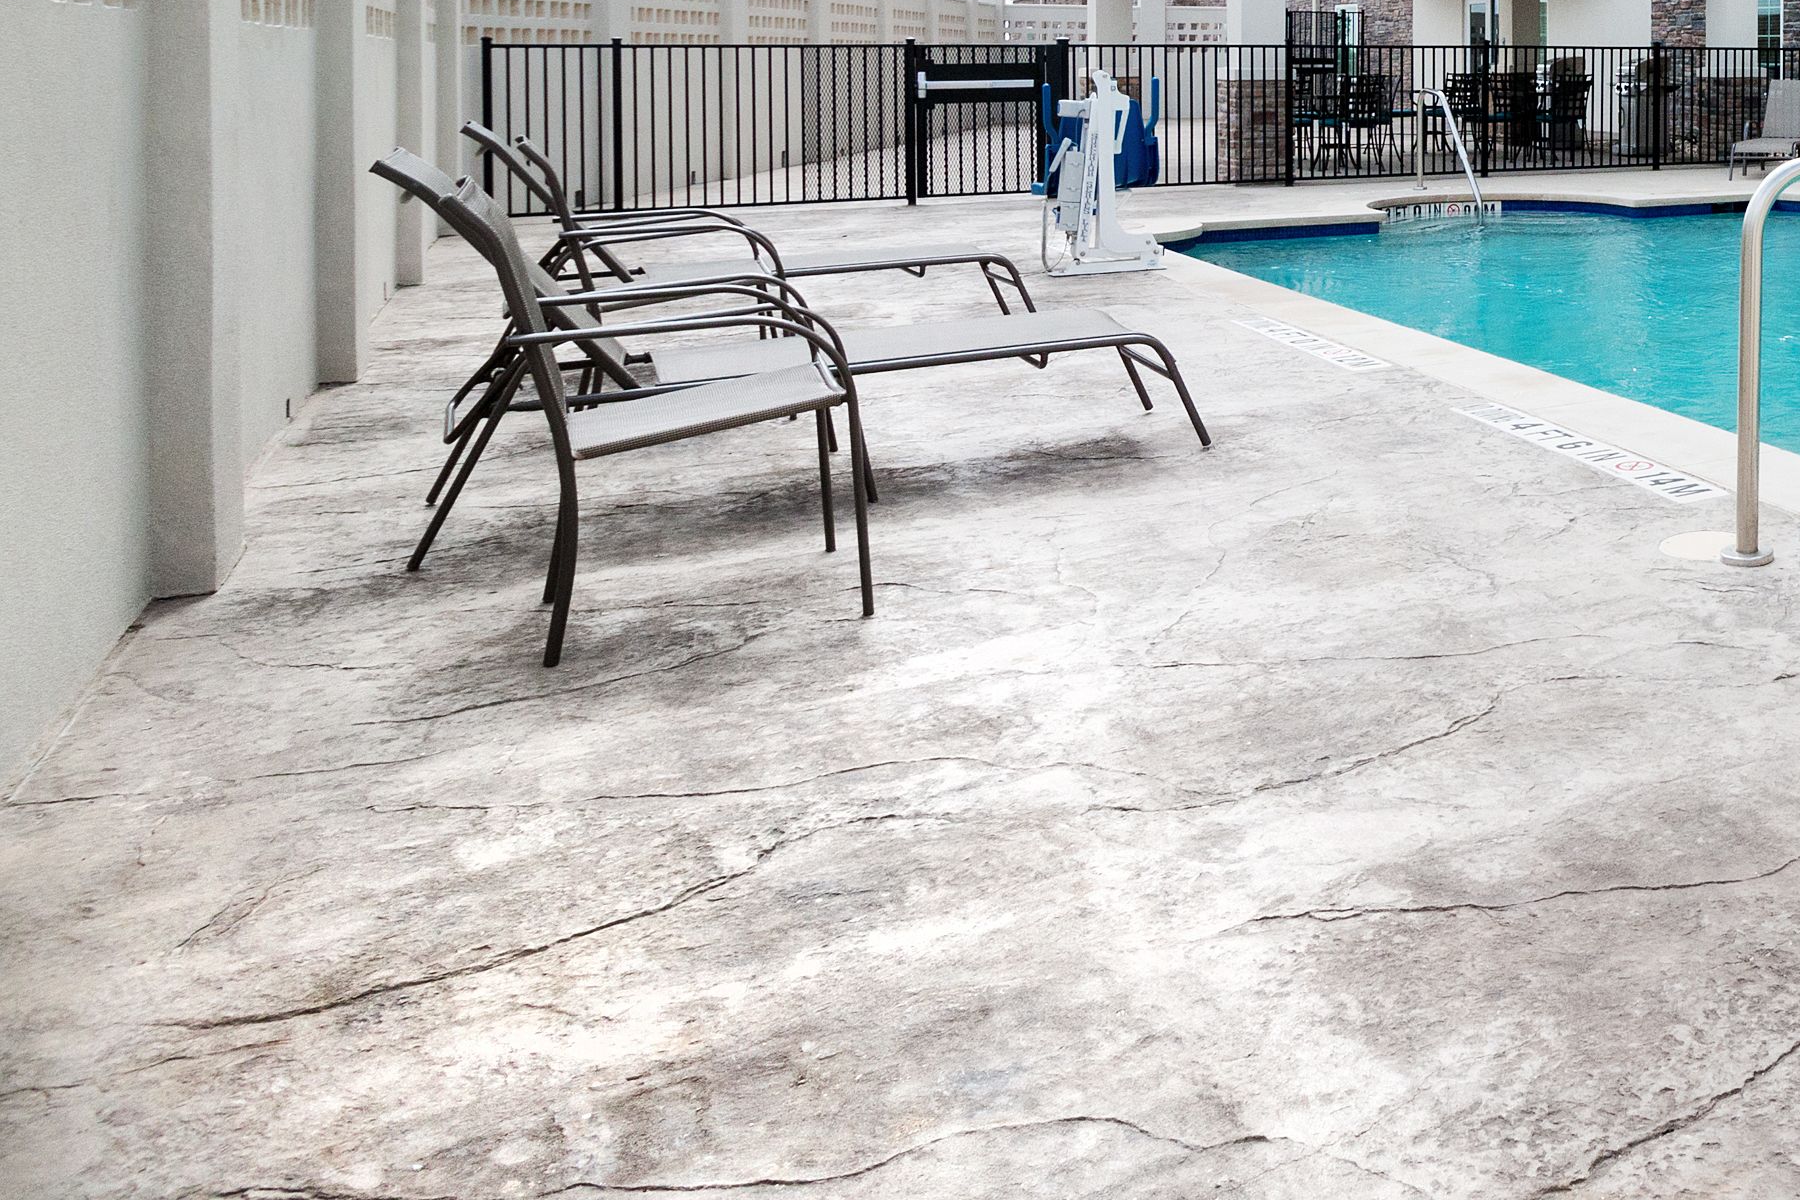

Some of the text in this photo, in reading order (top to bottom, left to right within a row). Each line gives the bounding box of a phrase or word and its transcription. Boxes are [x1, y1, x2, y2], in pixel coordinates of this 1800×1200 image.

[1428, 203, 1441, 217] IN
[1524, 429, 1574, 441] FT
[1556, 441, 1593, 450] 6
[1577, 449, 1628, 462] IN
